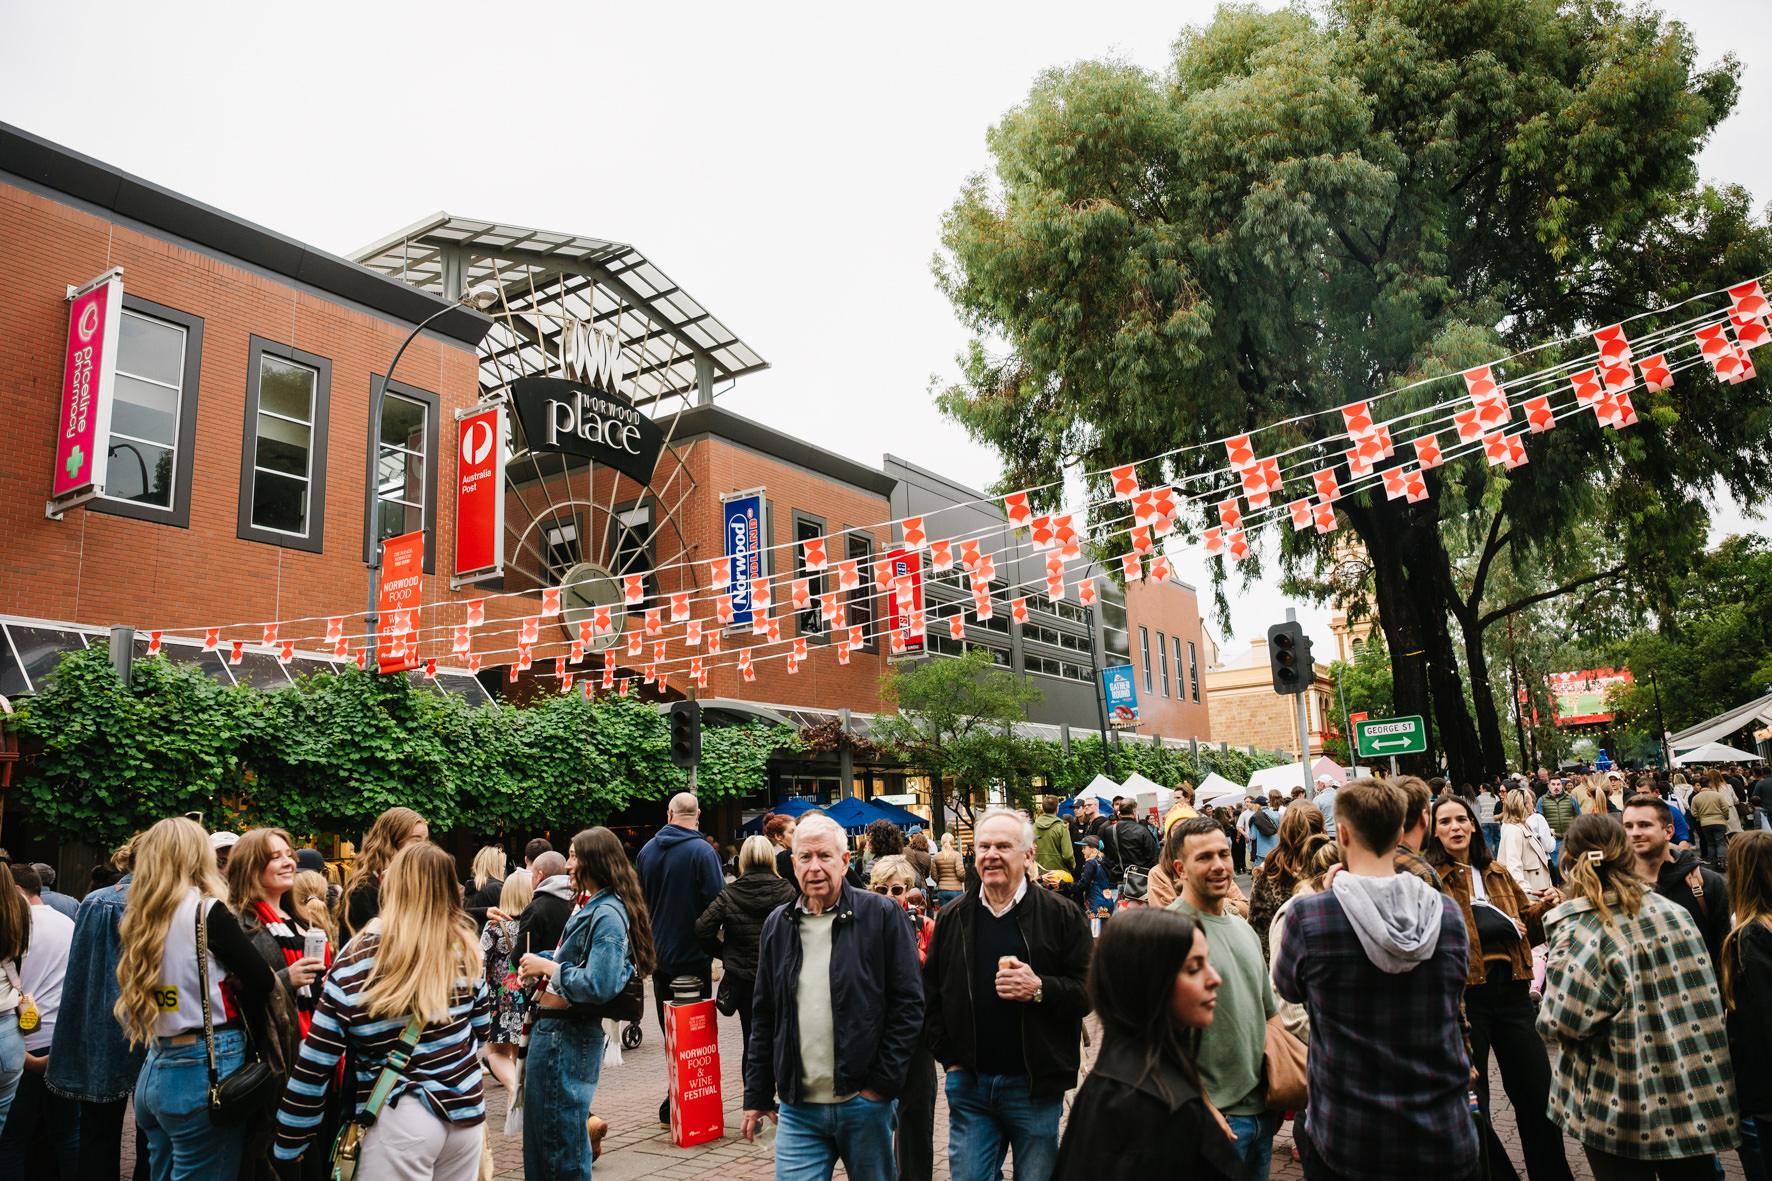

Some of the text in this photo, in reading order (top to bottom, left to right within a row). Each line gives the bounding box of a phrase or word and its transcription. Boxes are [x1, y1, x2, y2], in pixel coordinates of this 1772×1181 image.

[66, 351, 83, 439] pharmacy
[77, 346, 93, 433] priceline
[582, 393, 640, 425] NORWOOD
[546, 390, 641, 455] place
[462, 469, 492, 484] Australia
[462, 483, 477, 495] Post
[731, 522, 747, 605] Norwood
[383, 575, 419, 593] NORWOOD
[389, 588, 412, 603] FOOD
[1367, 723, 1412, 735] GEORGE ST
[680, 1044, 717, 1060] NORWOOD
[687, 1055, 712, 1069] FOOD
[697, 1068, 705, 1077] &
[689, 1075, 713, 1089] WINE
[684, 1085, 718, 1101] FESTIVAL
